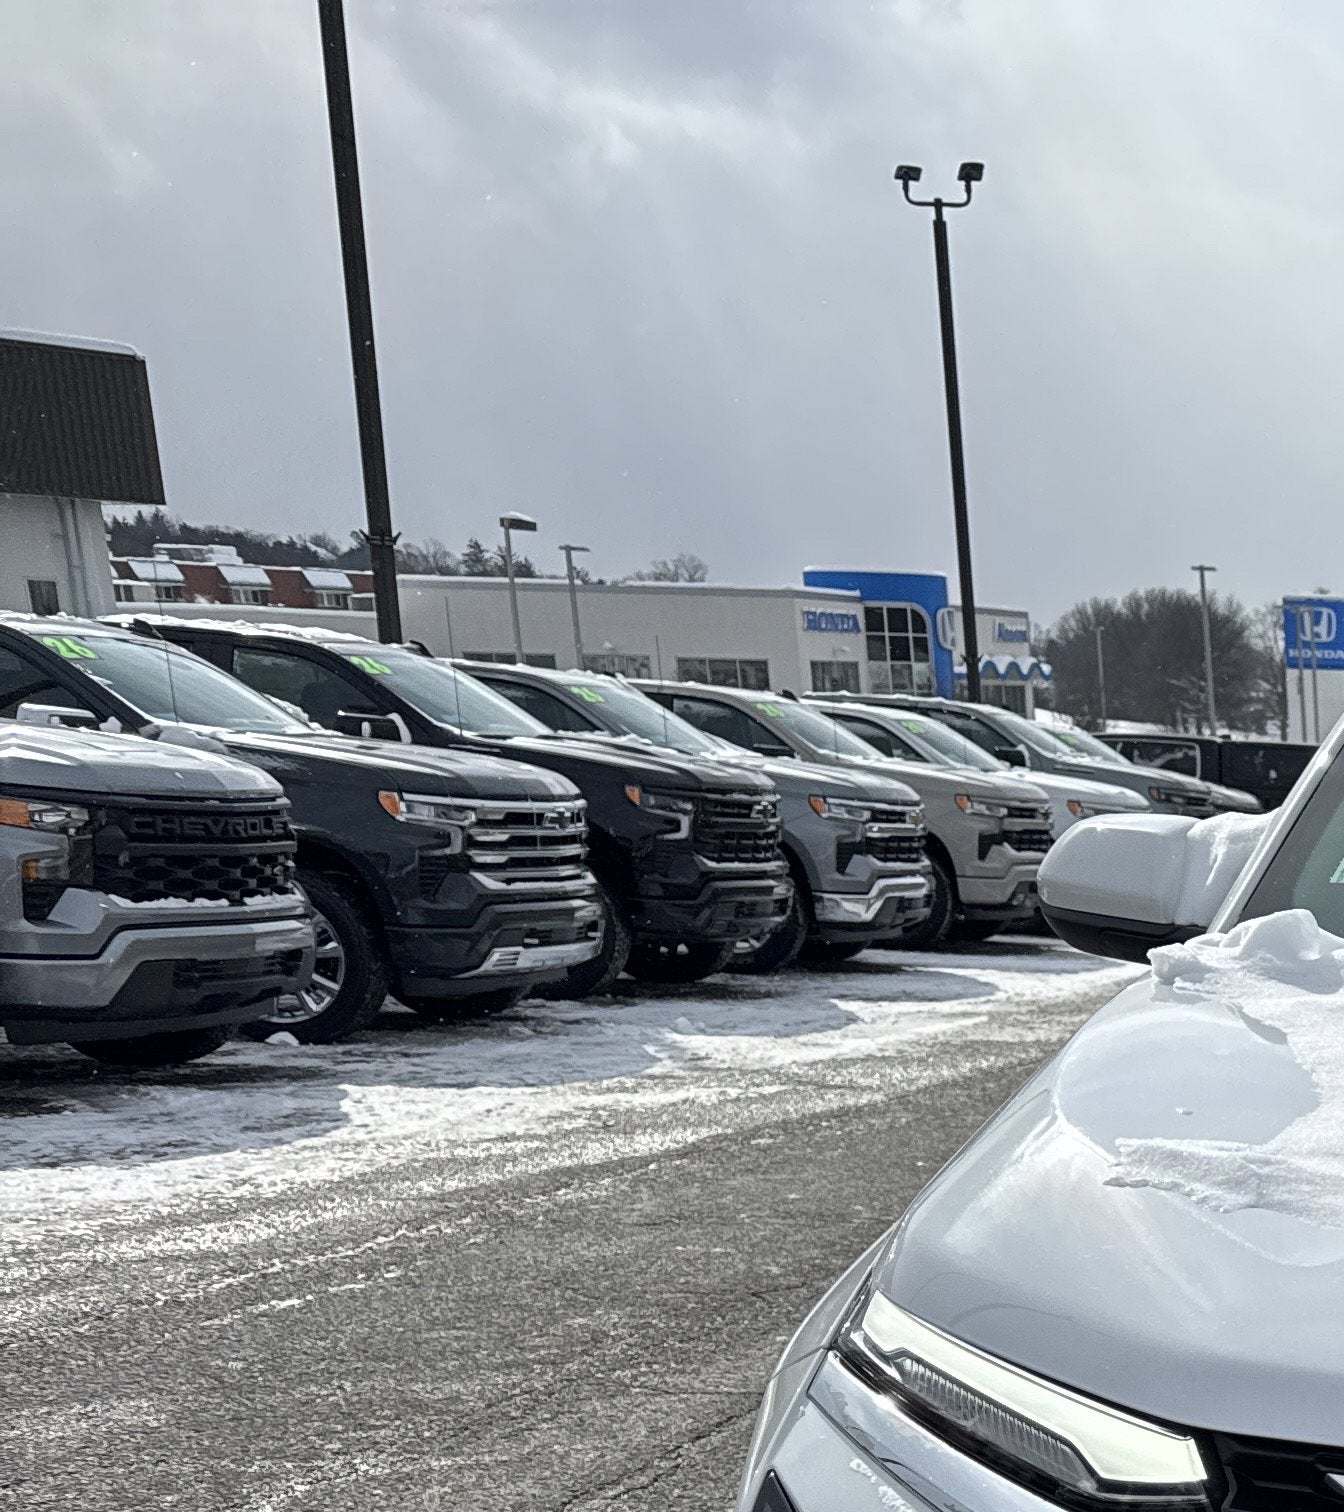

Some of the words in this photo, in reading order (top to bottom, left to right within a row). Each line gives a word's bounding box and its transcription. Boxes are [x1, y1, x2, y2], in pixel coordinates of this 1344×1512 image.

[803, 609, 861, 634] HONDA
[42, 636, 98, 660] 26
[134, 813, 288, 838] CHEVROLE
